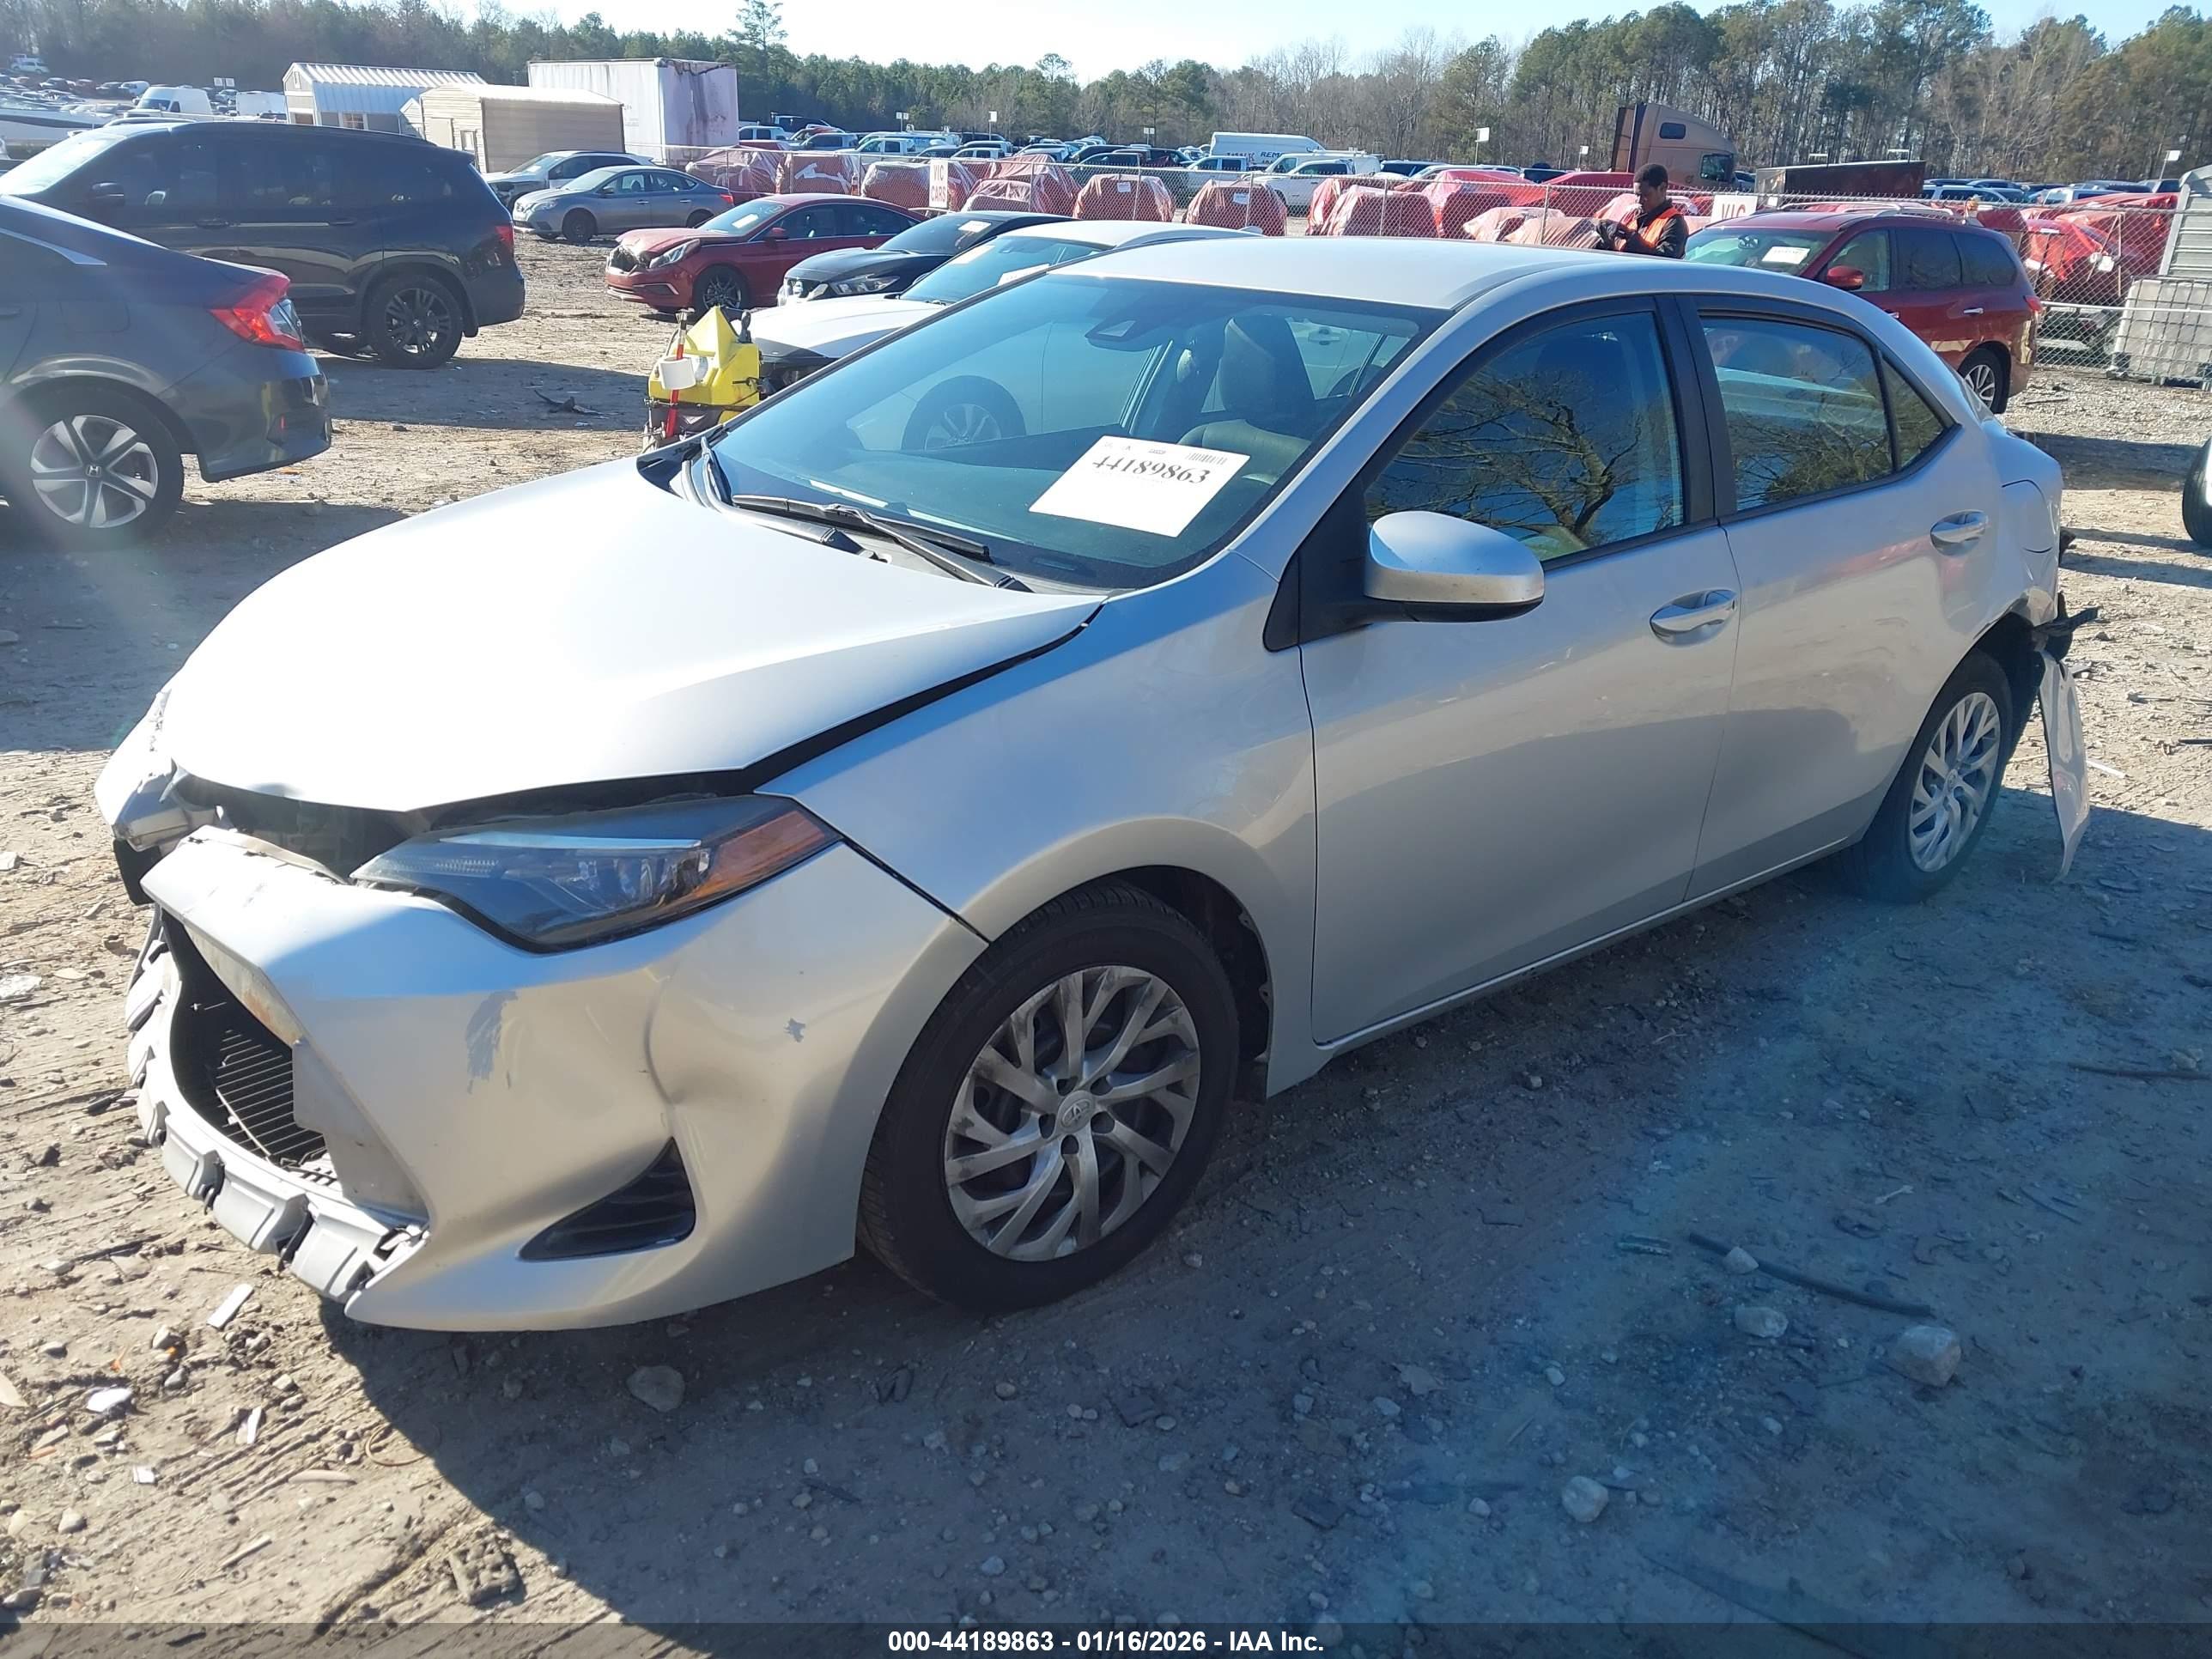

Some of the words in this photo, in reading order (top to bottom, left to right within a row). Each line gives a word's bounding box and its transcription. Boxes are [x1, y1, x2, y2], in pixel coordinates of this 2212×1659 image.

[933, 164, 945, 181] VIC
[931, 185, 946, 203] CARS
[1091, 455, 1211, 483] 44189863
